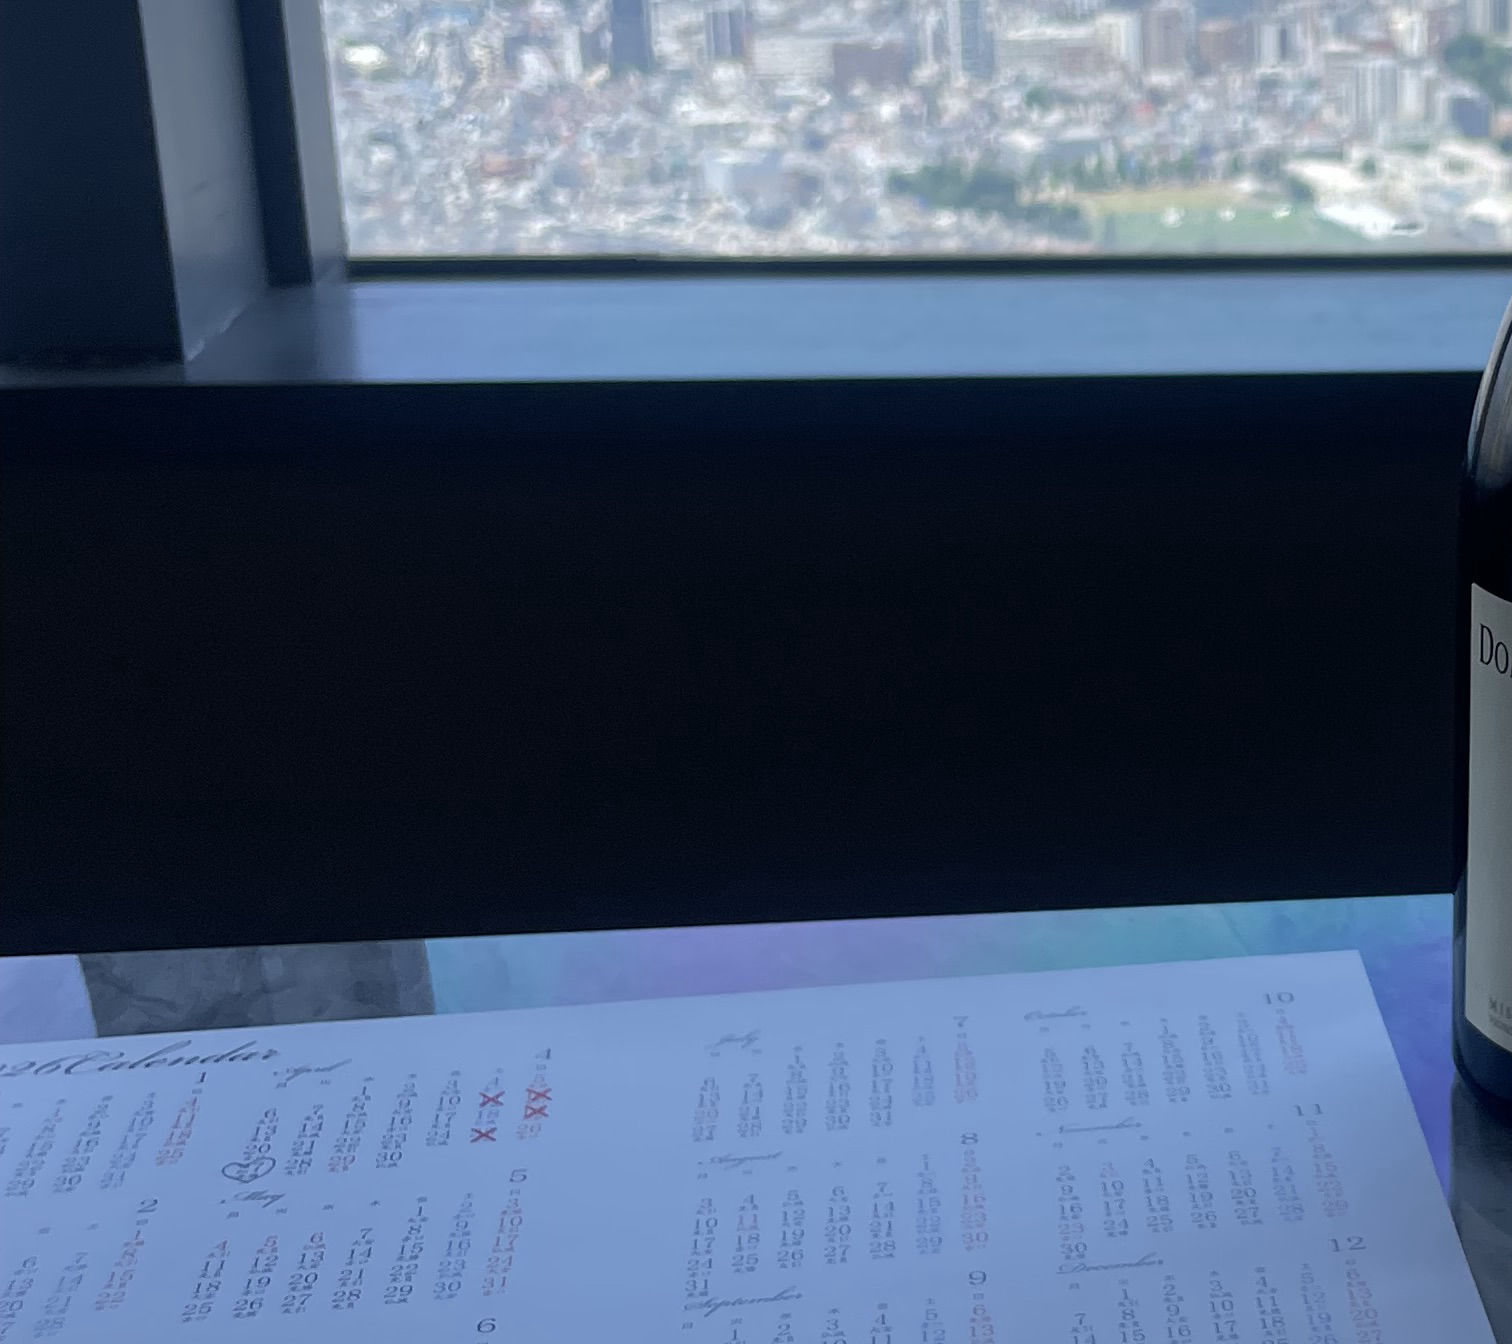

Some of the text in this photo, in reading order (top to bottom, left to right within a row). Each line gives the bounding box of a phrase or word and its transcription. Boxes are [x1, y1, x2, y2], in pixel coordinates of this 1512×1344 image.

[509, 1169, 527, 1183] 5
[1331, 1236, 1367, 1253] 12
[968, 1270, 987, 1286] 9
[476, 1318, 496, 1334] 6
